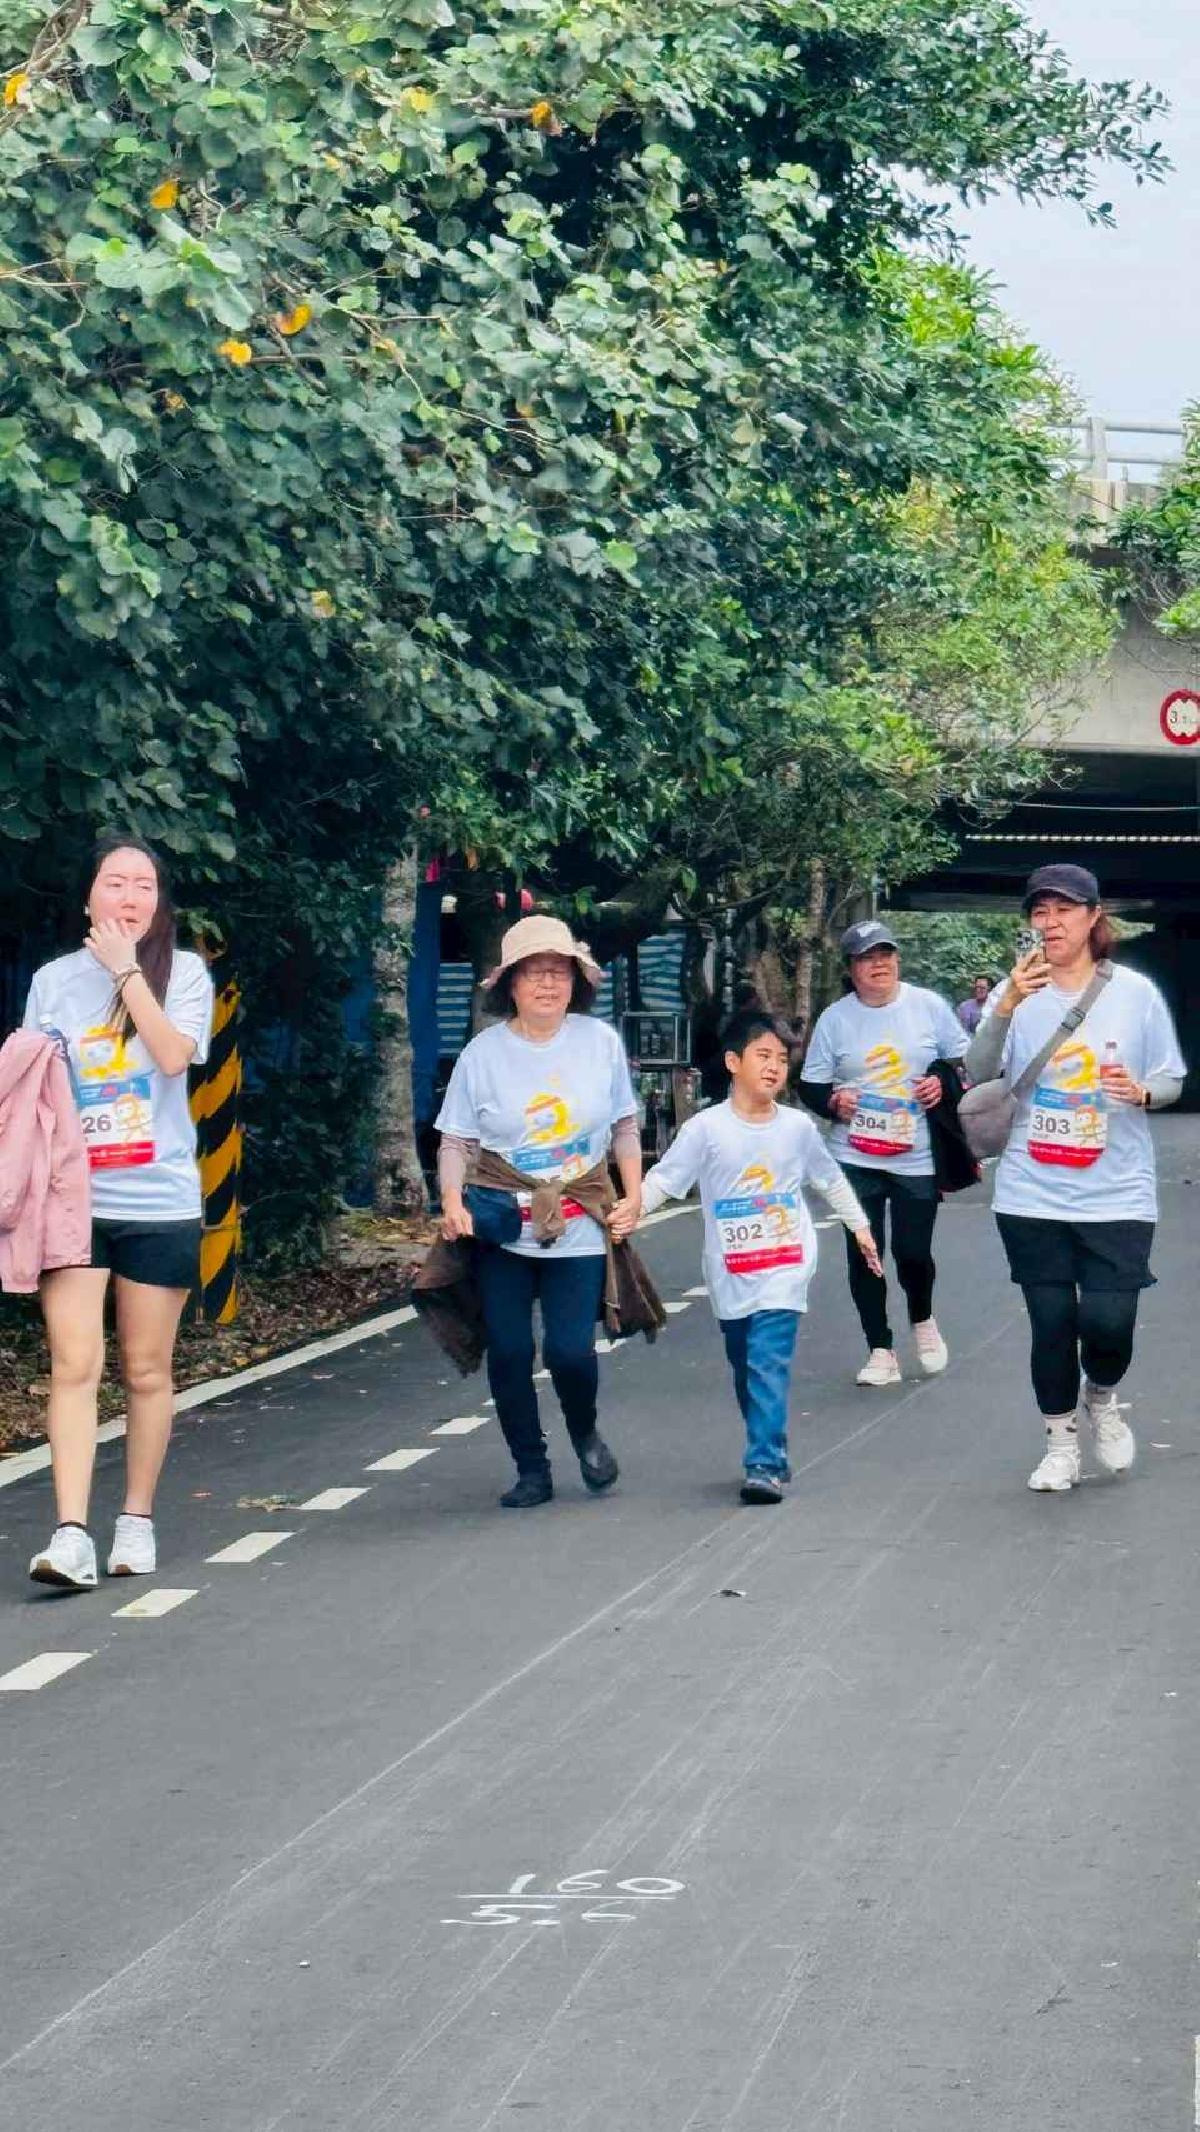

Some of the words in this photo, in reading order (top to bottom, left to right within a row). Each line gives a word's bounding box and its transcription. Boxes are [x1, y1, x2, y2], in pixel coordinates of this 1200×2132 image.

[855, 1114, 886, 1130] 304
[1032, 1114, 1071, 1135] 303
[724, 1223, 762, 1243] 302
[509, 1869, 686, 1894] 160
